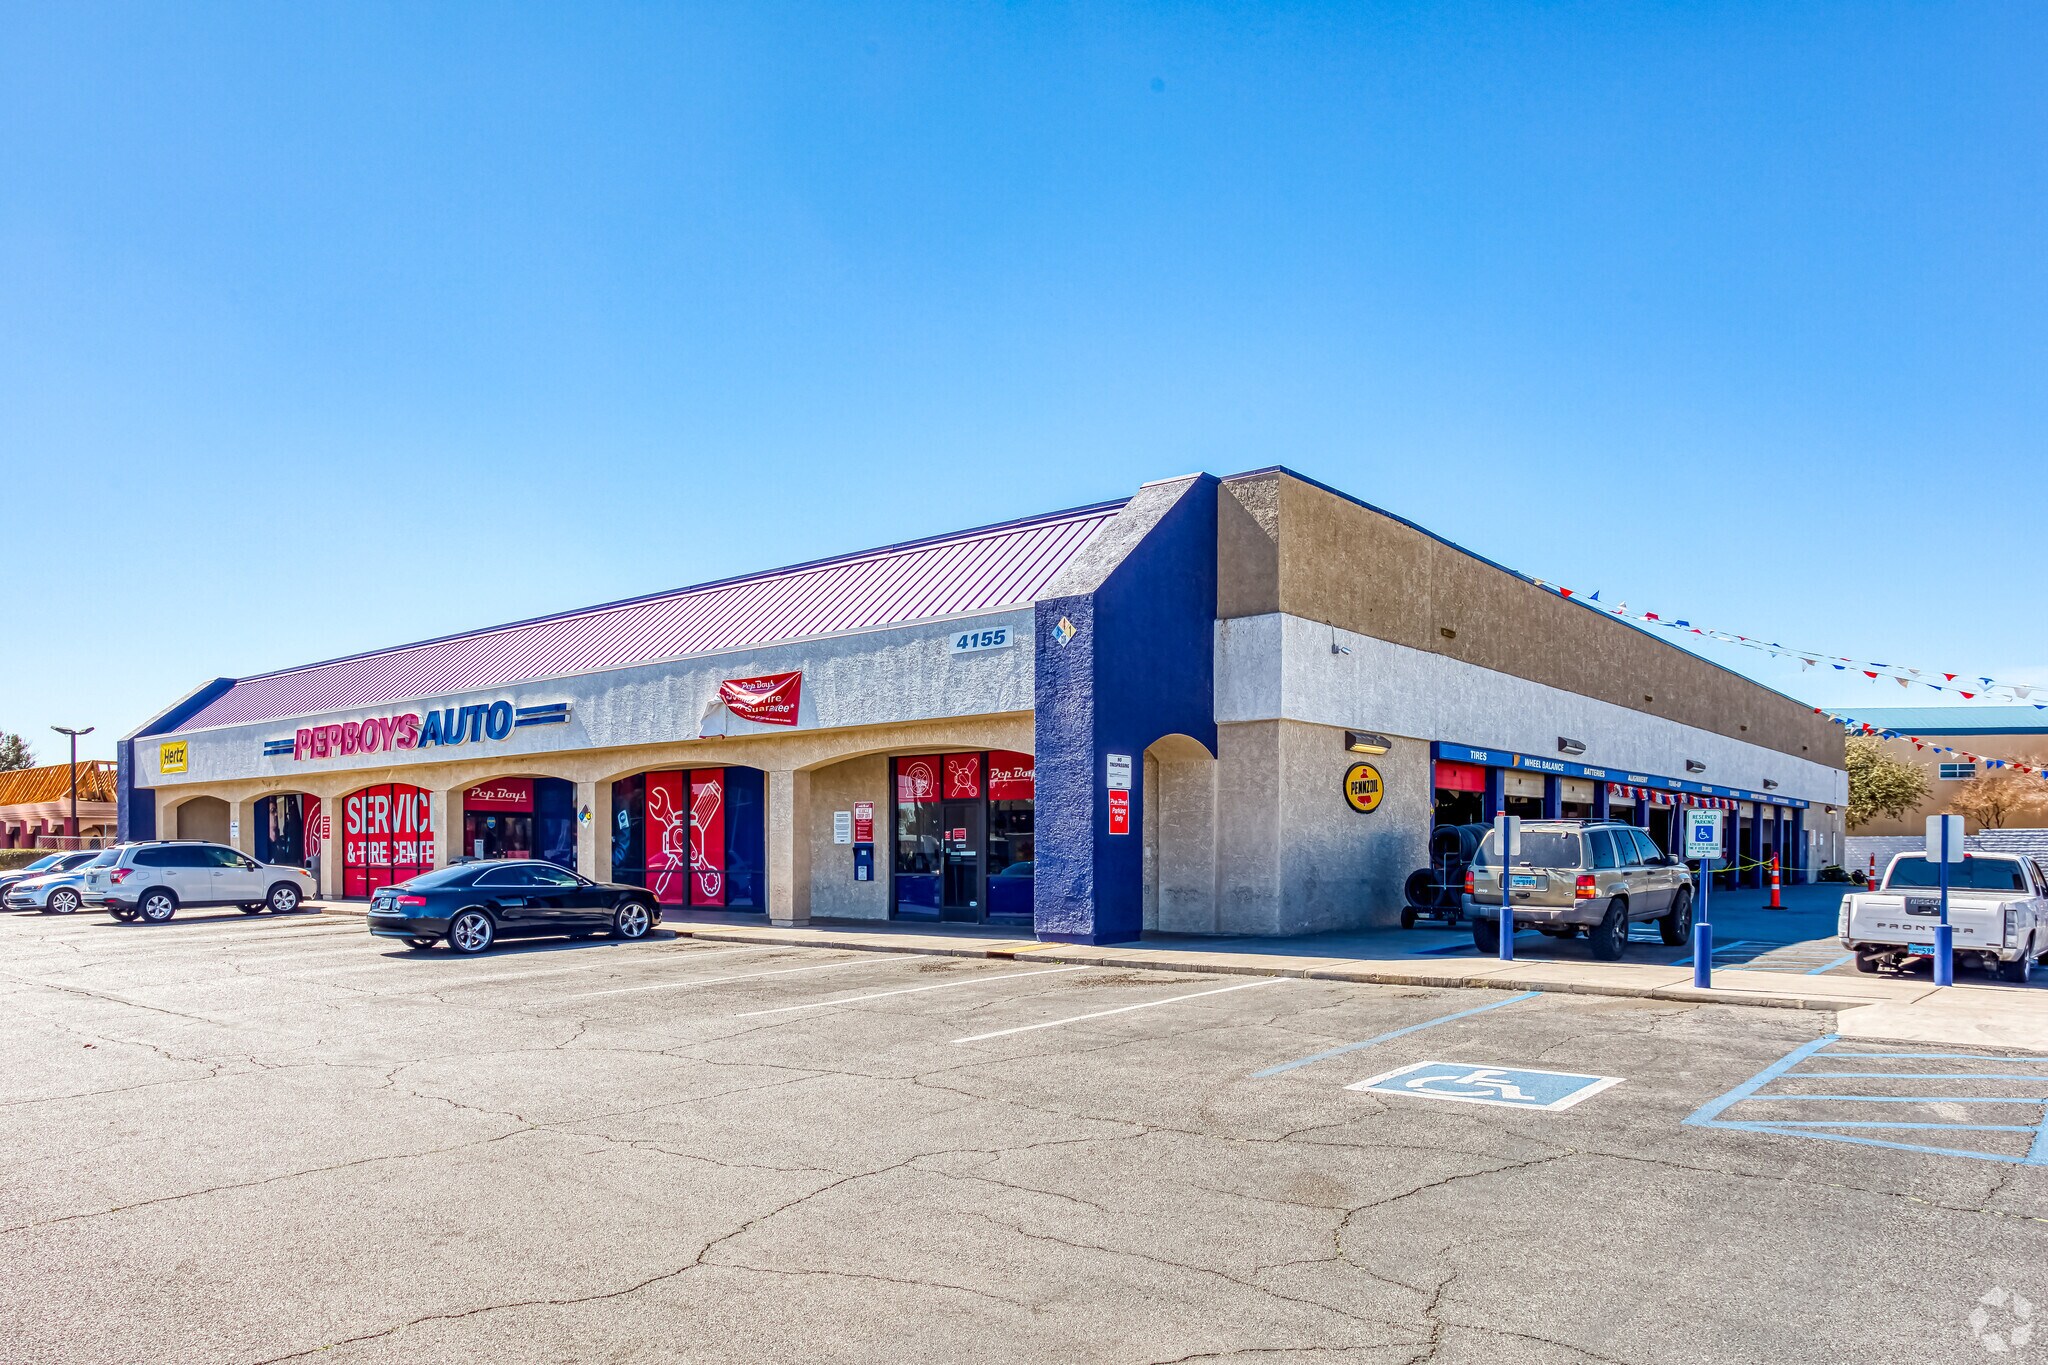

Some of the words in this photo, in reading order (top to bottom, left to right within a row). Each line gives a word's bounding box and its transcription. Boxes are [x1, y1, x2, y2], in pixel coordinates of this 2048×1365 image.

[956, 629, 1006, 649] 4155
[418, 700, 515, 748] AUTO
[164, 747, 184, 764] Hertz
[1470, 750, 1487, 761] TIRES
[1524, 758, 1541, 769] WHEEL
[1542, 760, 1564, 772] BALANCE
[990, 768, 1012, 781] Pep
[1013, 767, 1035, 781] Boy
[1583, 767, 1605, 778] BATTERIES
[1350, 779, 1378, 795] PENNZOIL
[472, 788, 495, 800] Pep
[497, 788, 527, 802] Boys
[1114, 815, 1123, 823] Only
[347, 842, 356, 863] &
[358, 841, 387, 863] TIRE
[393, 841, 434, 863] CENTE
[1877, 923, 1973, 933] FRONTER
